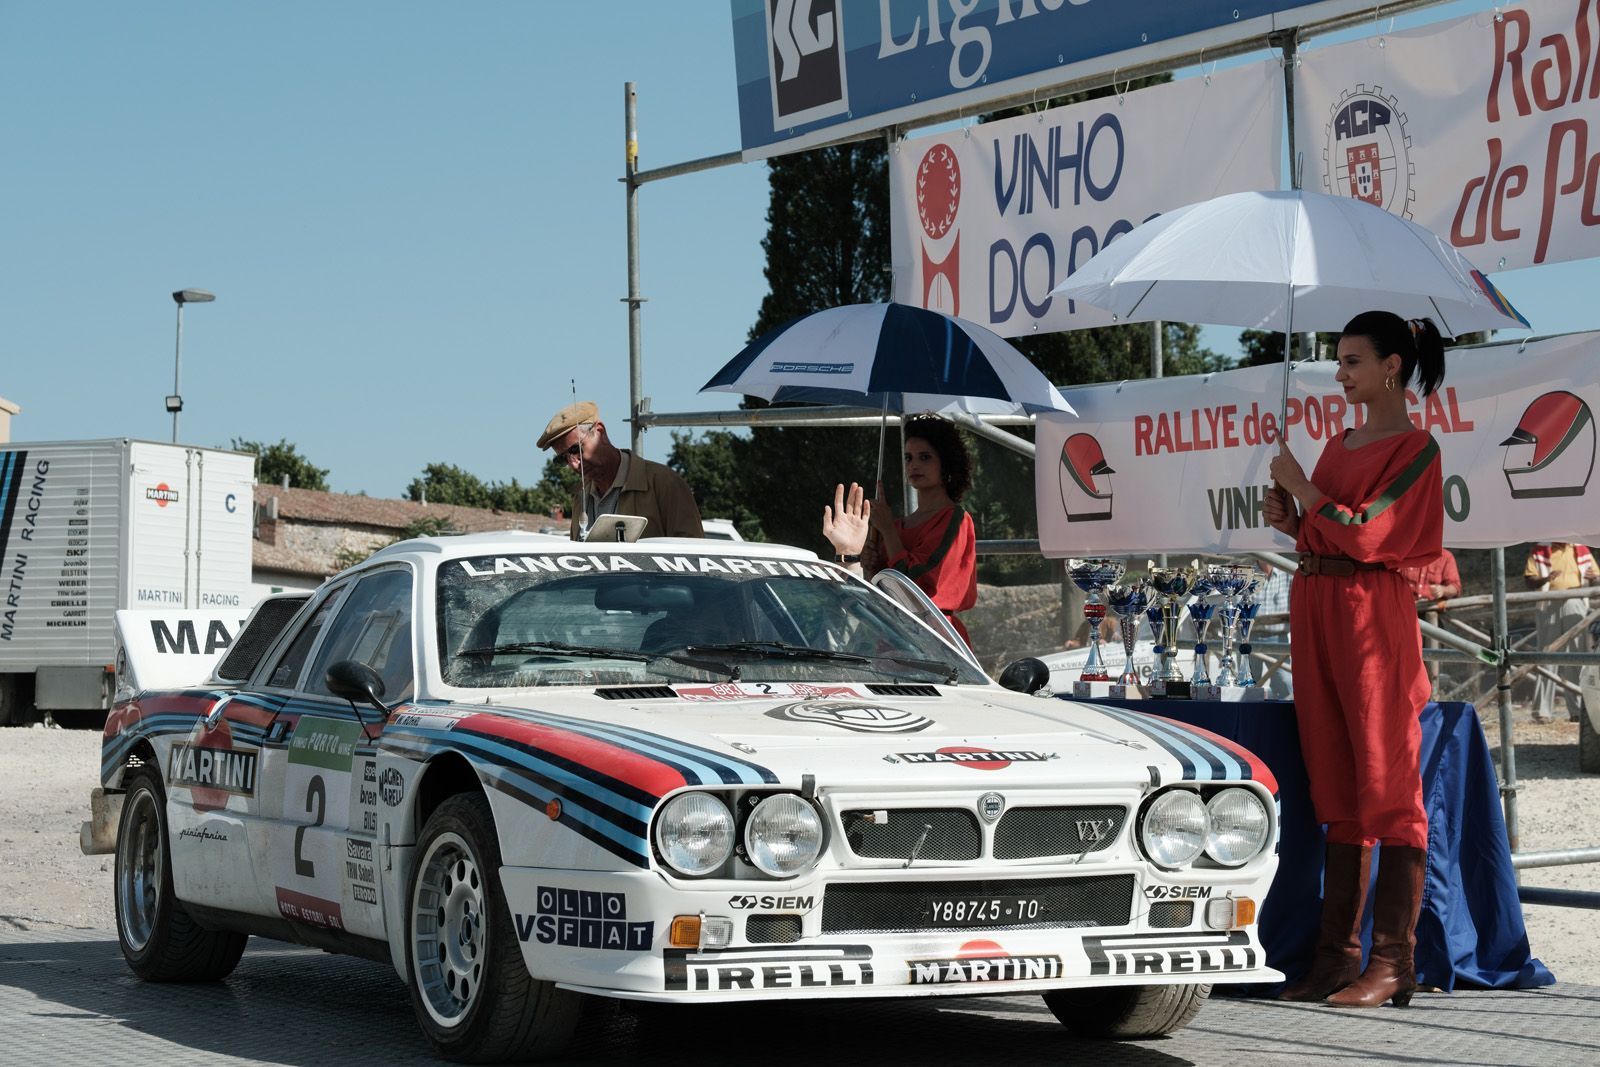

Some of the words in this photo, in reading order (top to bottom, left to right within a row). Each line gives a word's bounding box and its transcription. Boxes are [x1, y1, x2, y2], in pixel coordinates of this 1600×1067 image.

[1334, 99, 1391, 141] ACP
[994, 113, 1124, 217] VINHO
[1451, 138, 1528, 248] de
[989, 232, 1055, 324] DO
[771, 363, 853, 374] PORSCHE
[1134, 405, 1239, 456] RALLYE
[1243, 401, 1277, 445] de
[1285, 387, 1474, 441] PORTGAL
[21, 459, 50, 542] RACING
[147, 489, 178, 501] MARTINI
[225, 494, 236, 513] C
[1207, 484, 1304, 531] VINH
[459, 555, 641, 577] LANCIA
[651, 556, 846, 582] MARTINI
[1, 553, 28, 641] MARTINI
[138, 589, 182, 603] MARTINI
[202, 593, 239, 606] RACING
[150, 619, 246, 655] MA
[712, 684, 740, 696] 1983
[756, 683, 778, 694] 2
[308, 732, 340, 754] PORTO
[904, 752, 1040, 762] MARTINI
[169, 748, 254, 789] MARTINI
[294, 775, 326, 878] 2
[540, 890, 621, 914] OLIO
[760, 895, 814, 910] SIEM
[1168, 885, 1213, 899] SIEM
[280, 901, 299, 917] HOTEL
[931, 900, 1001, 922] Y88745
[1016, 899, 1039, 919] TO
[515, 914, 556, 945] VS
[560, 918, 647, 946] FIAT
[663, 944, 874, 991] PIRELLI
[1082, 930, 1257, 976] PIRELLI
[914, 956, 1061, 984] MARTINI
